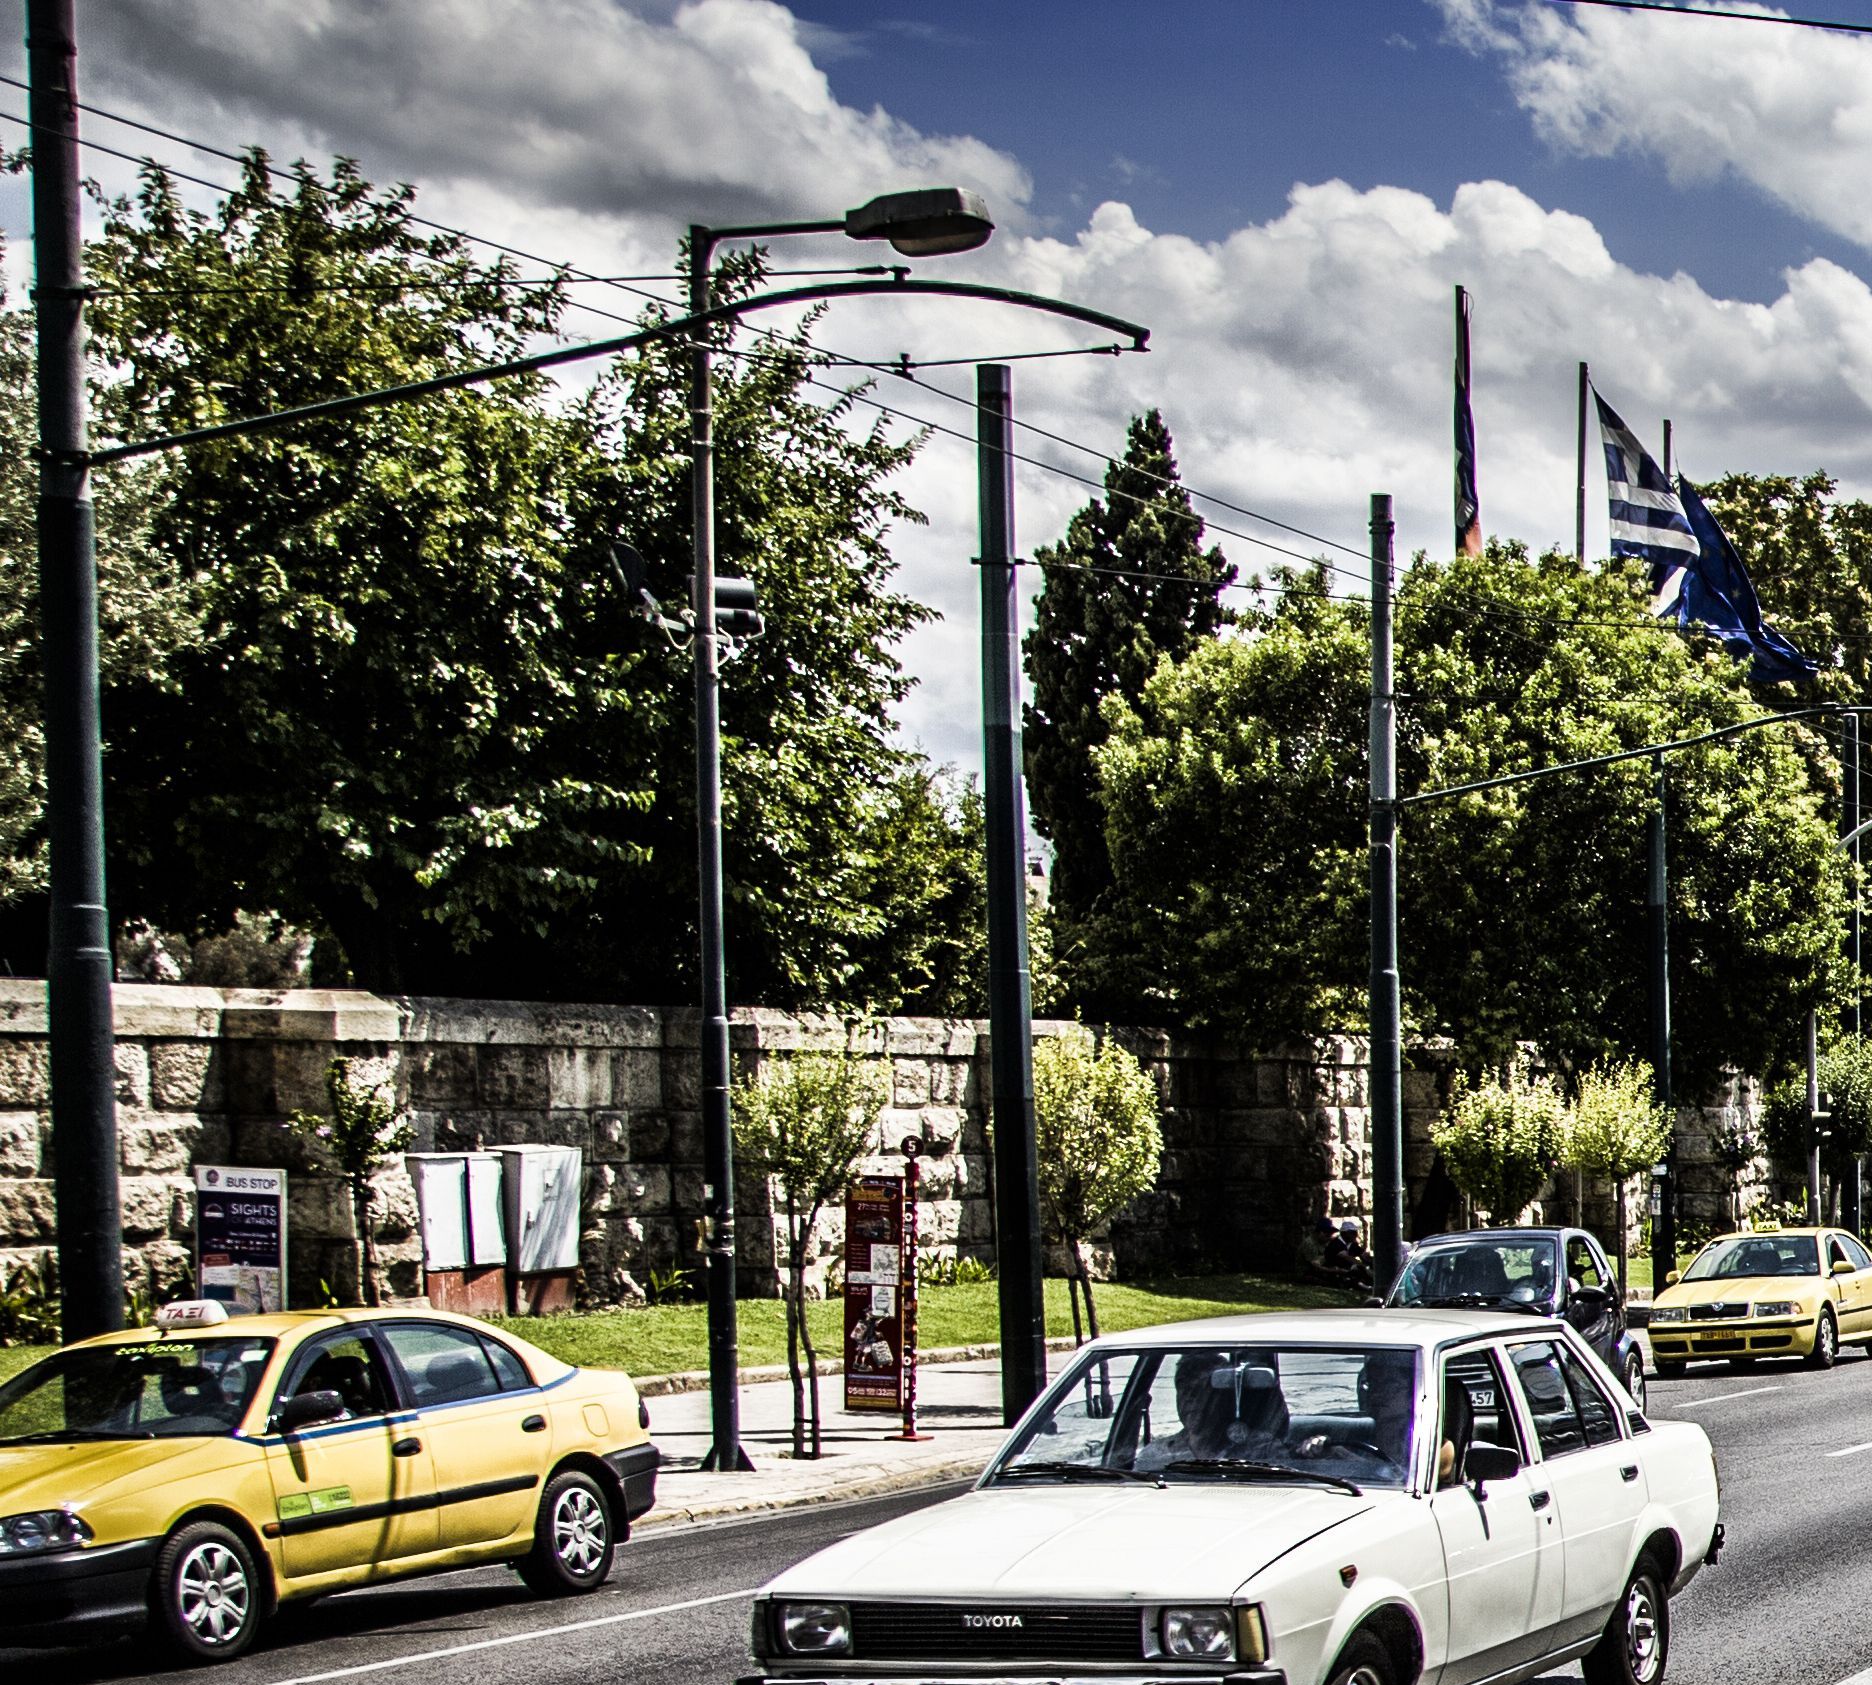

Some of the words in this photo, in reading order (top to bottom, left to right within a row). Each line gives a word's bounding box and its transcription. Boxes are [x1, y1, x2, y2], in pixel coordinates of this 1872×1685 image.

[908, 1140, 917, 1152] 5
[226, 1176, 248, 1189] BUS
[250, 1178, 278, 1190] STOP
[231, 1203, 278, 1218] SIGHTS
[963, 1614, 1024, 1628] TOYOTA
